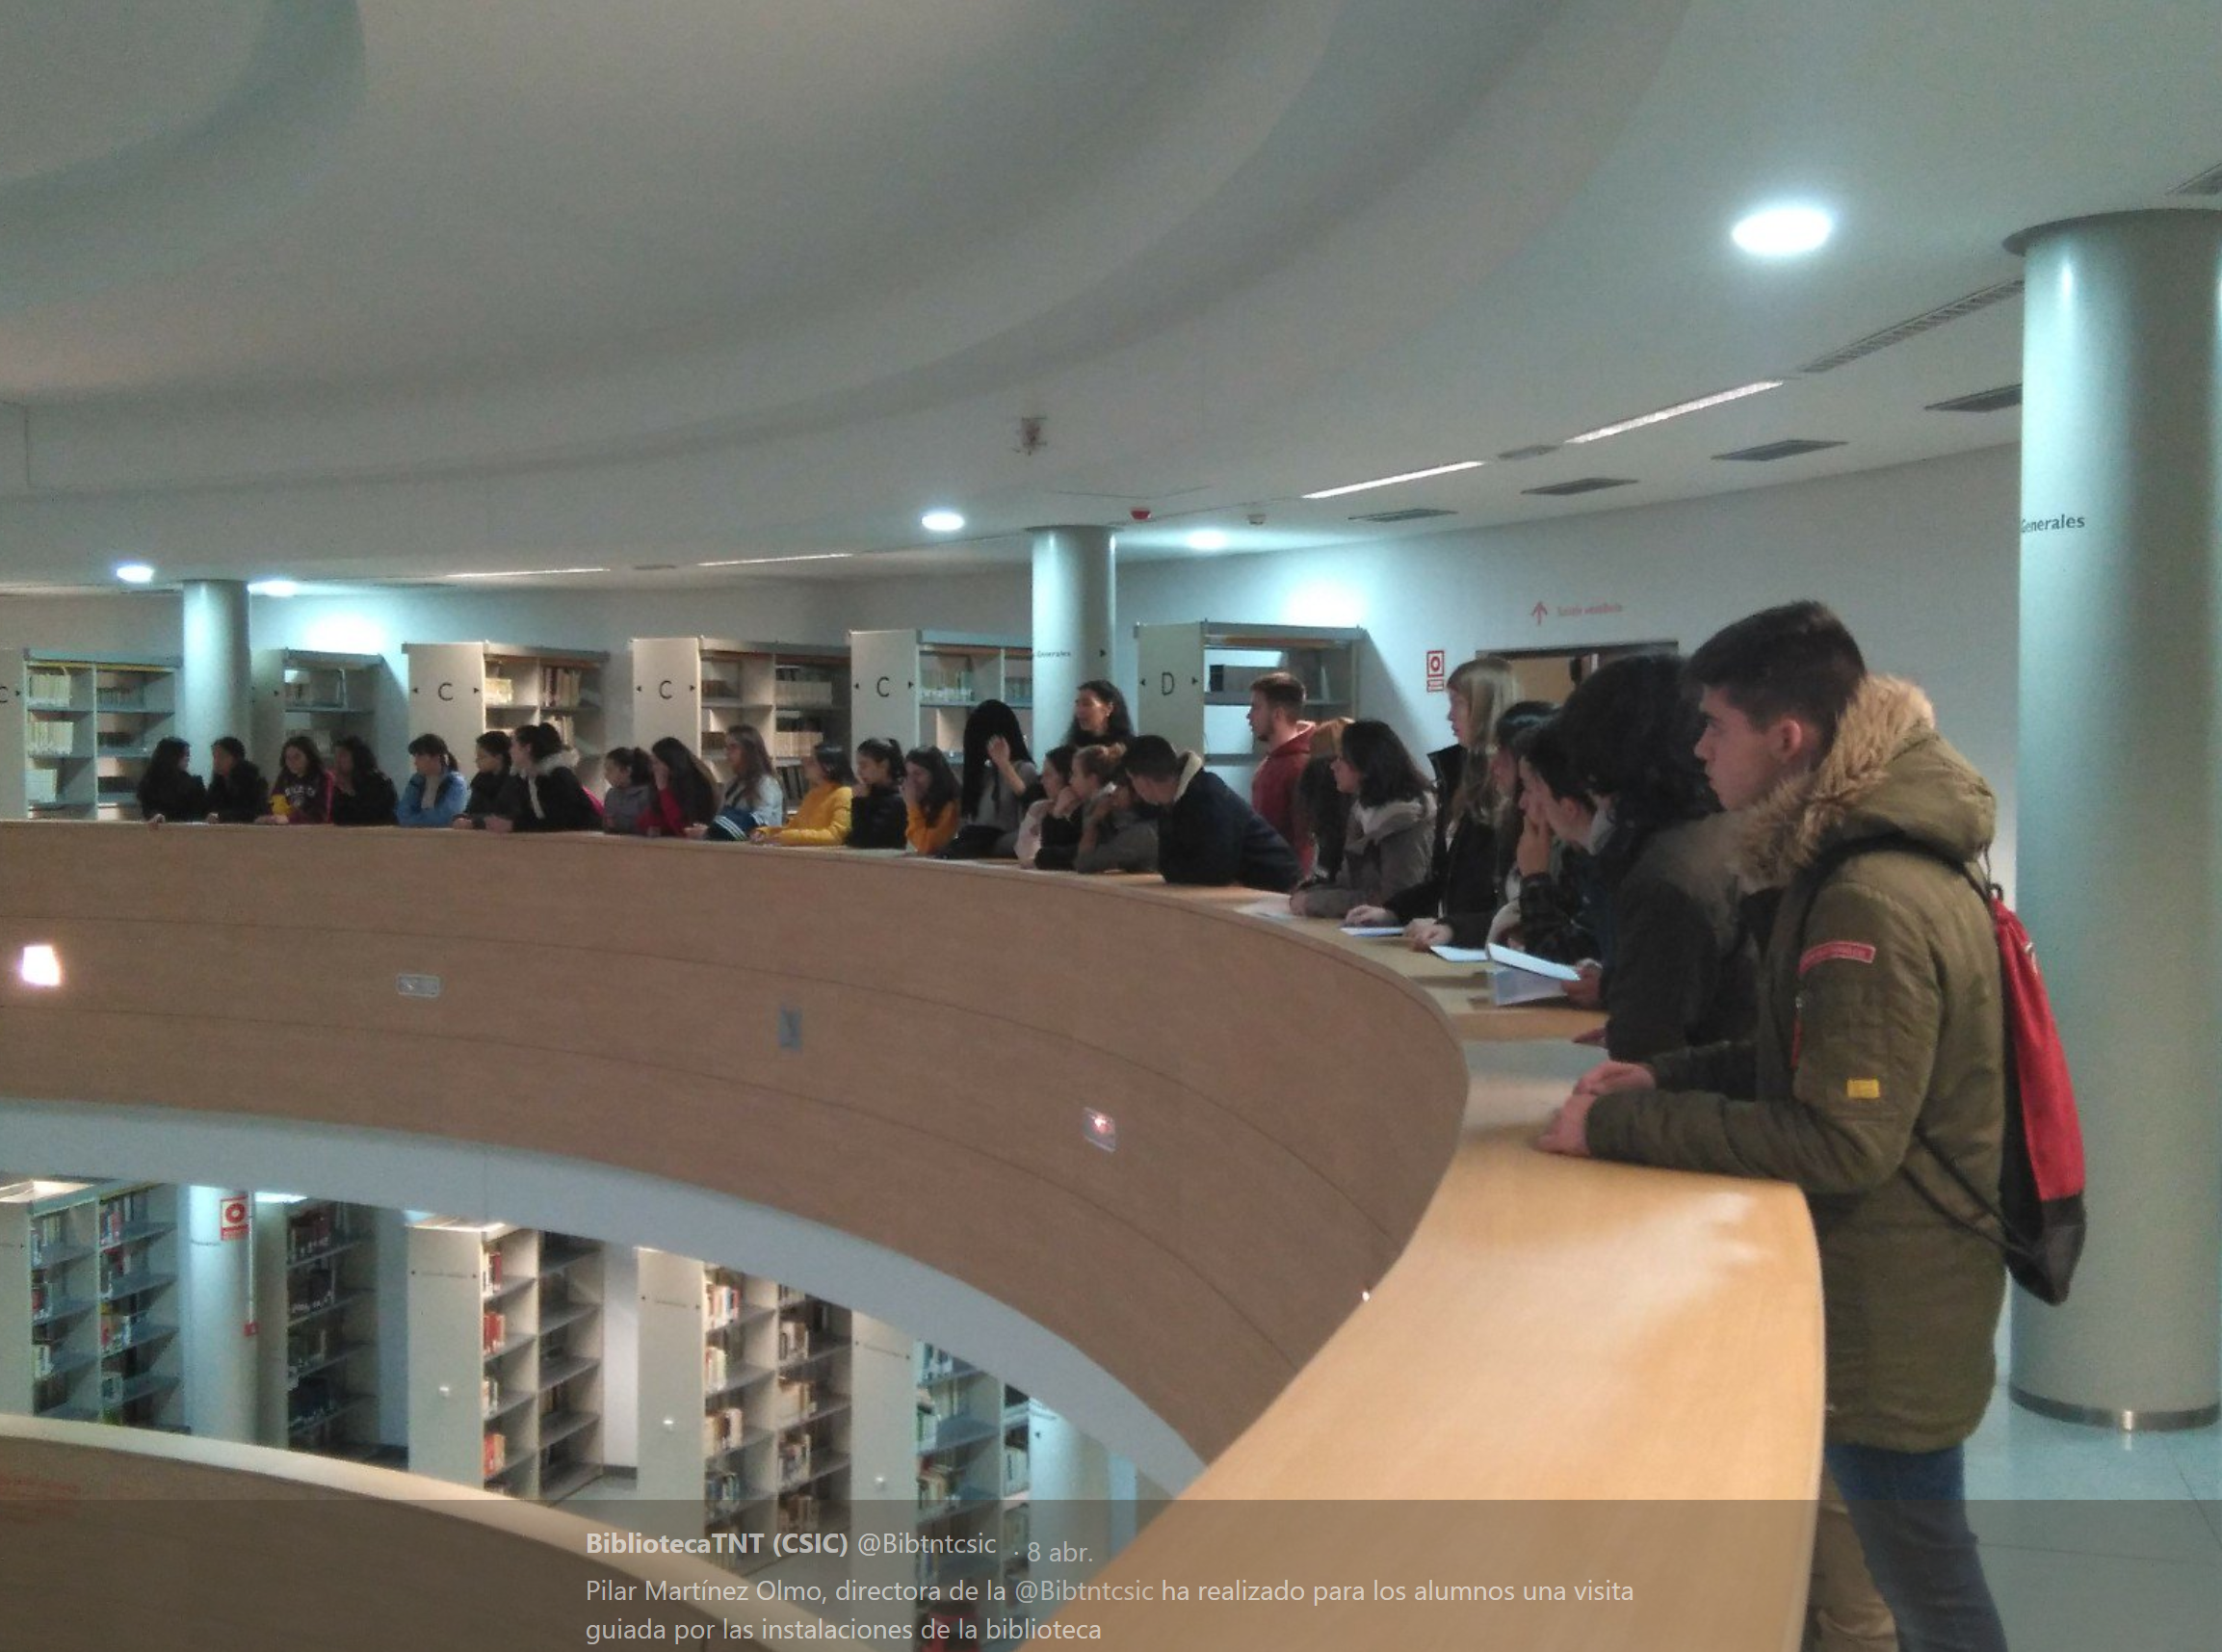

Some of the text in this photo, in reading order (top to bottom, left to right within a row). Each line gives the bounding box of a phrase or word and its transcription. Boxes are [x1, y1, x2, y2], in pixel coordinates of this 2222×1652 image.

[437, 682, 454, 701] C
[659, 680, 672, 699] C
[876, 676, 890, 697] C
[1162, 671, 1175, 695] D
